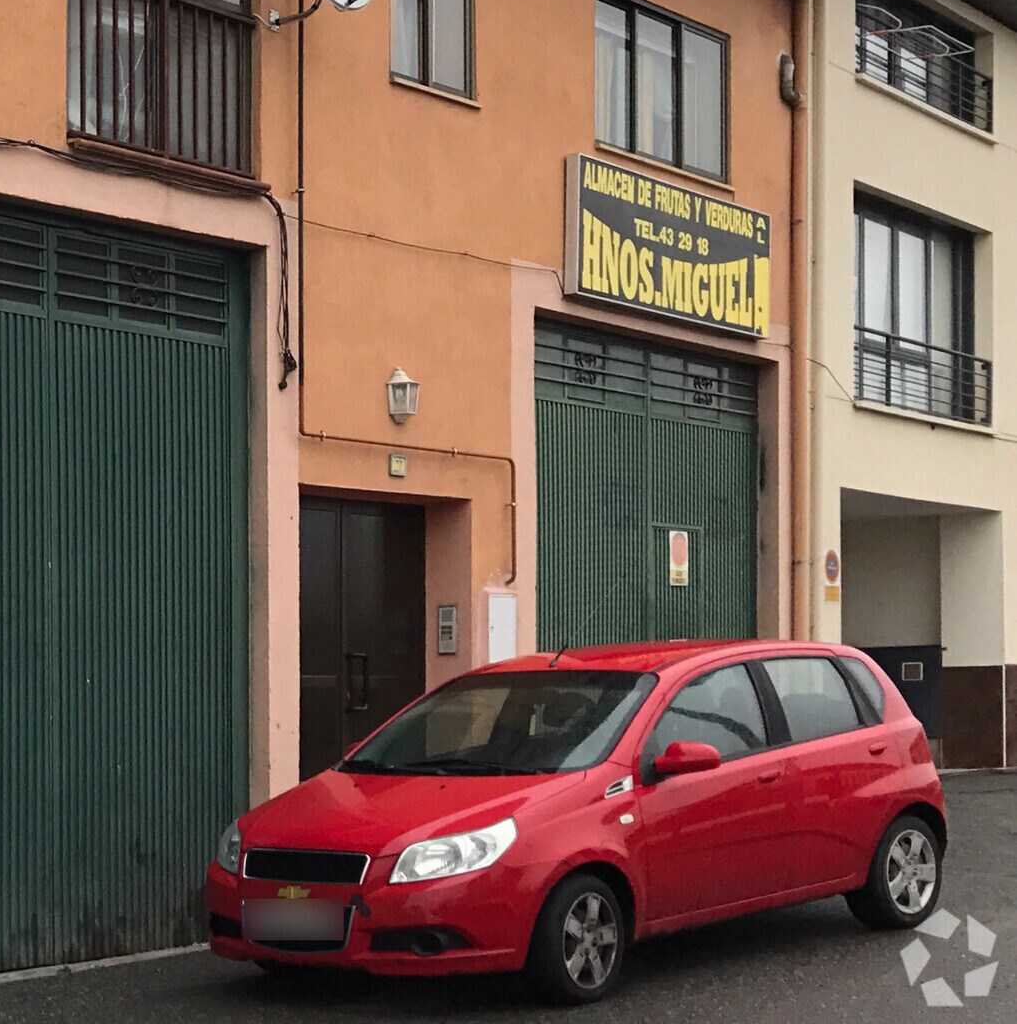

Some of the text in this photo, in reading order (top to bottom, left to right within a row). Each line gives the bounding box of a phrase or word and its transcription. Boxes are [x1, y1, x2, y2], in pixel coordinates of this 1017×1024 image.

[584, 161, 754, 239] ALMACEN DE FRUTAS Y VERDURAS
[678, 231, 693, 252] 29
[697, 237, 709, 256] 18
